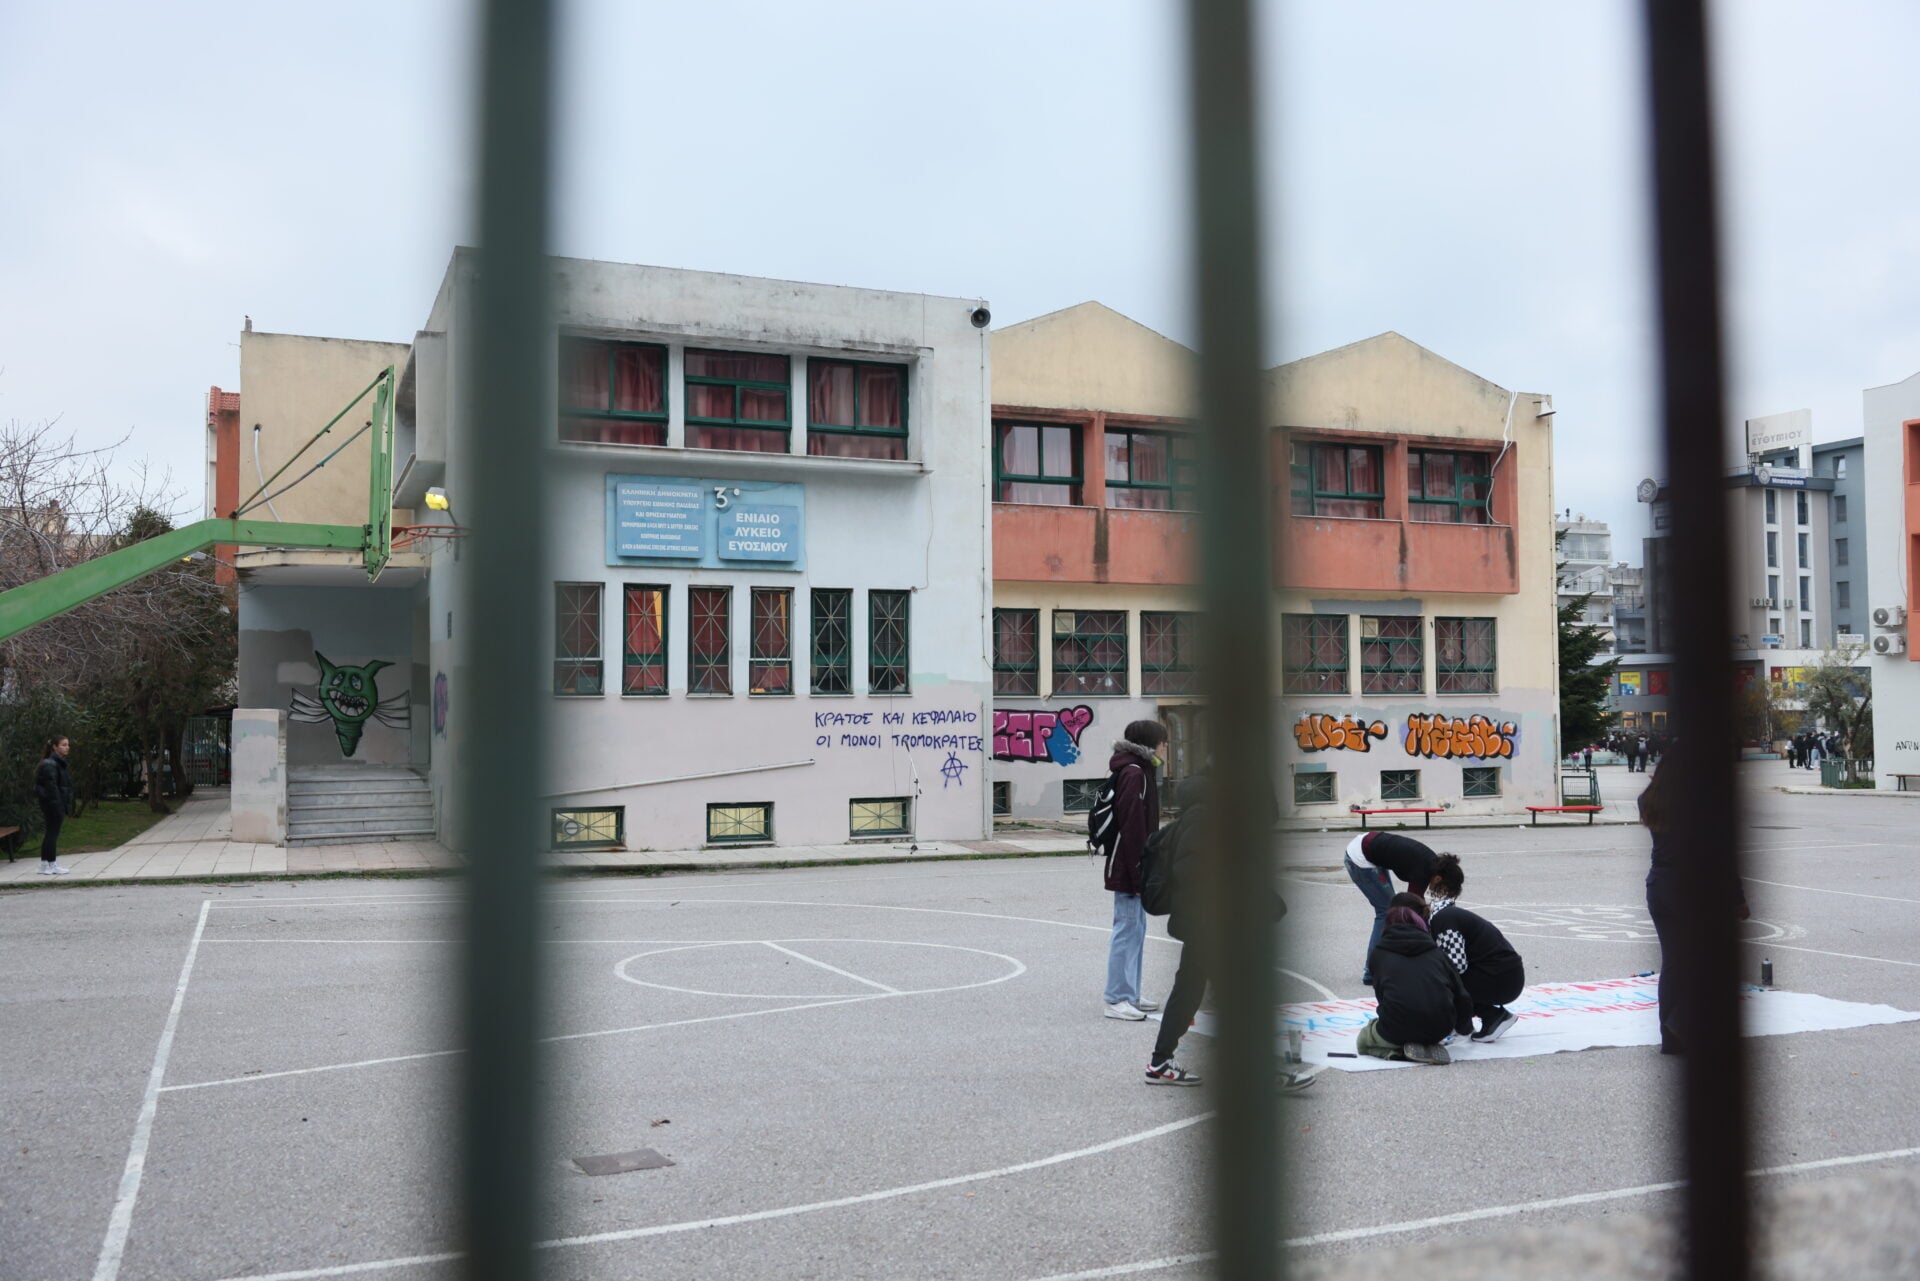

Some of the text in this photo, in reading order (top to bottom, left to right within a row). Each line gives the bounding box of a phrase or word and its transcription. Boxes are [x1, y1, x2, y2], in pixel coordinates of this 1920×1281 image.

[735, 512, 780, 523] ΕΝΙΑΙΟ
[734, 526, 781, 538] ΛΥΚΕΙΟ
[728, 540, 788, 552] ΕΥΟΣΜΟΥ
[815, 710, 977, 728] ΚΡΑΤΟΣ ΚΑΙ ΚΕΦΑΛΑΙΟ
[816, 734, 984, 752] ΟΙ ΜΟΝΟΙ ΤΡΟΜΟΚΡΑΤΕΣ
